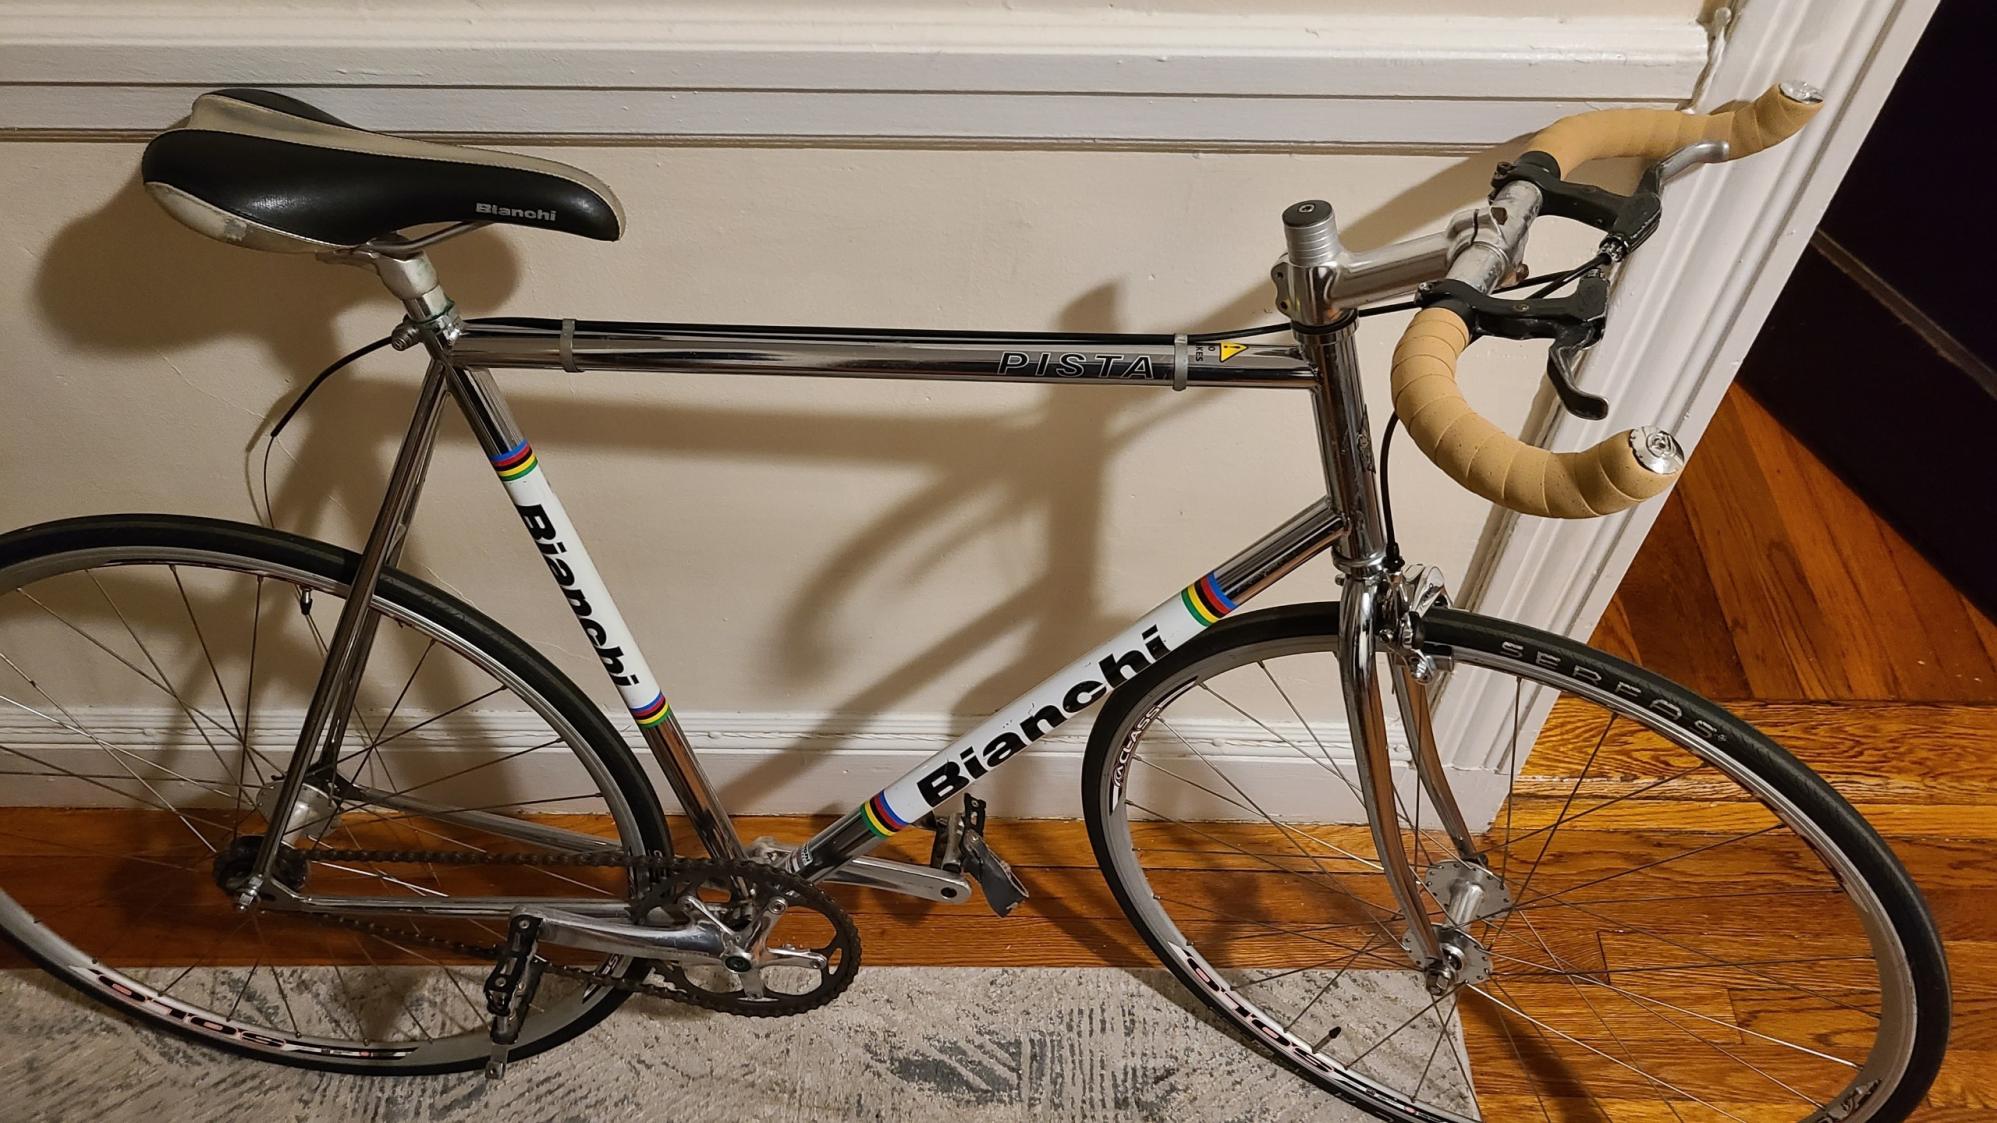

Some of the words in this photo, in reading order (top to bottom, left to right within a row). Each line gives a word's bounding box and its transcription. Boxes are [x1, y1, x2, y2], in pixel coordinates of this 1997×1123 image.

[475, 202, 557, 222] Bianchi
[997, 351, 1155, 380] PISTA
[515, 503, 640, 688] Bianchi
[916, 624, 1172, 808] Bianchi
